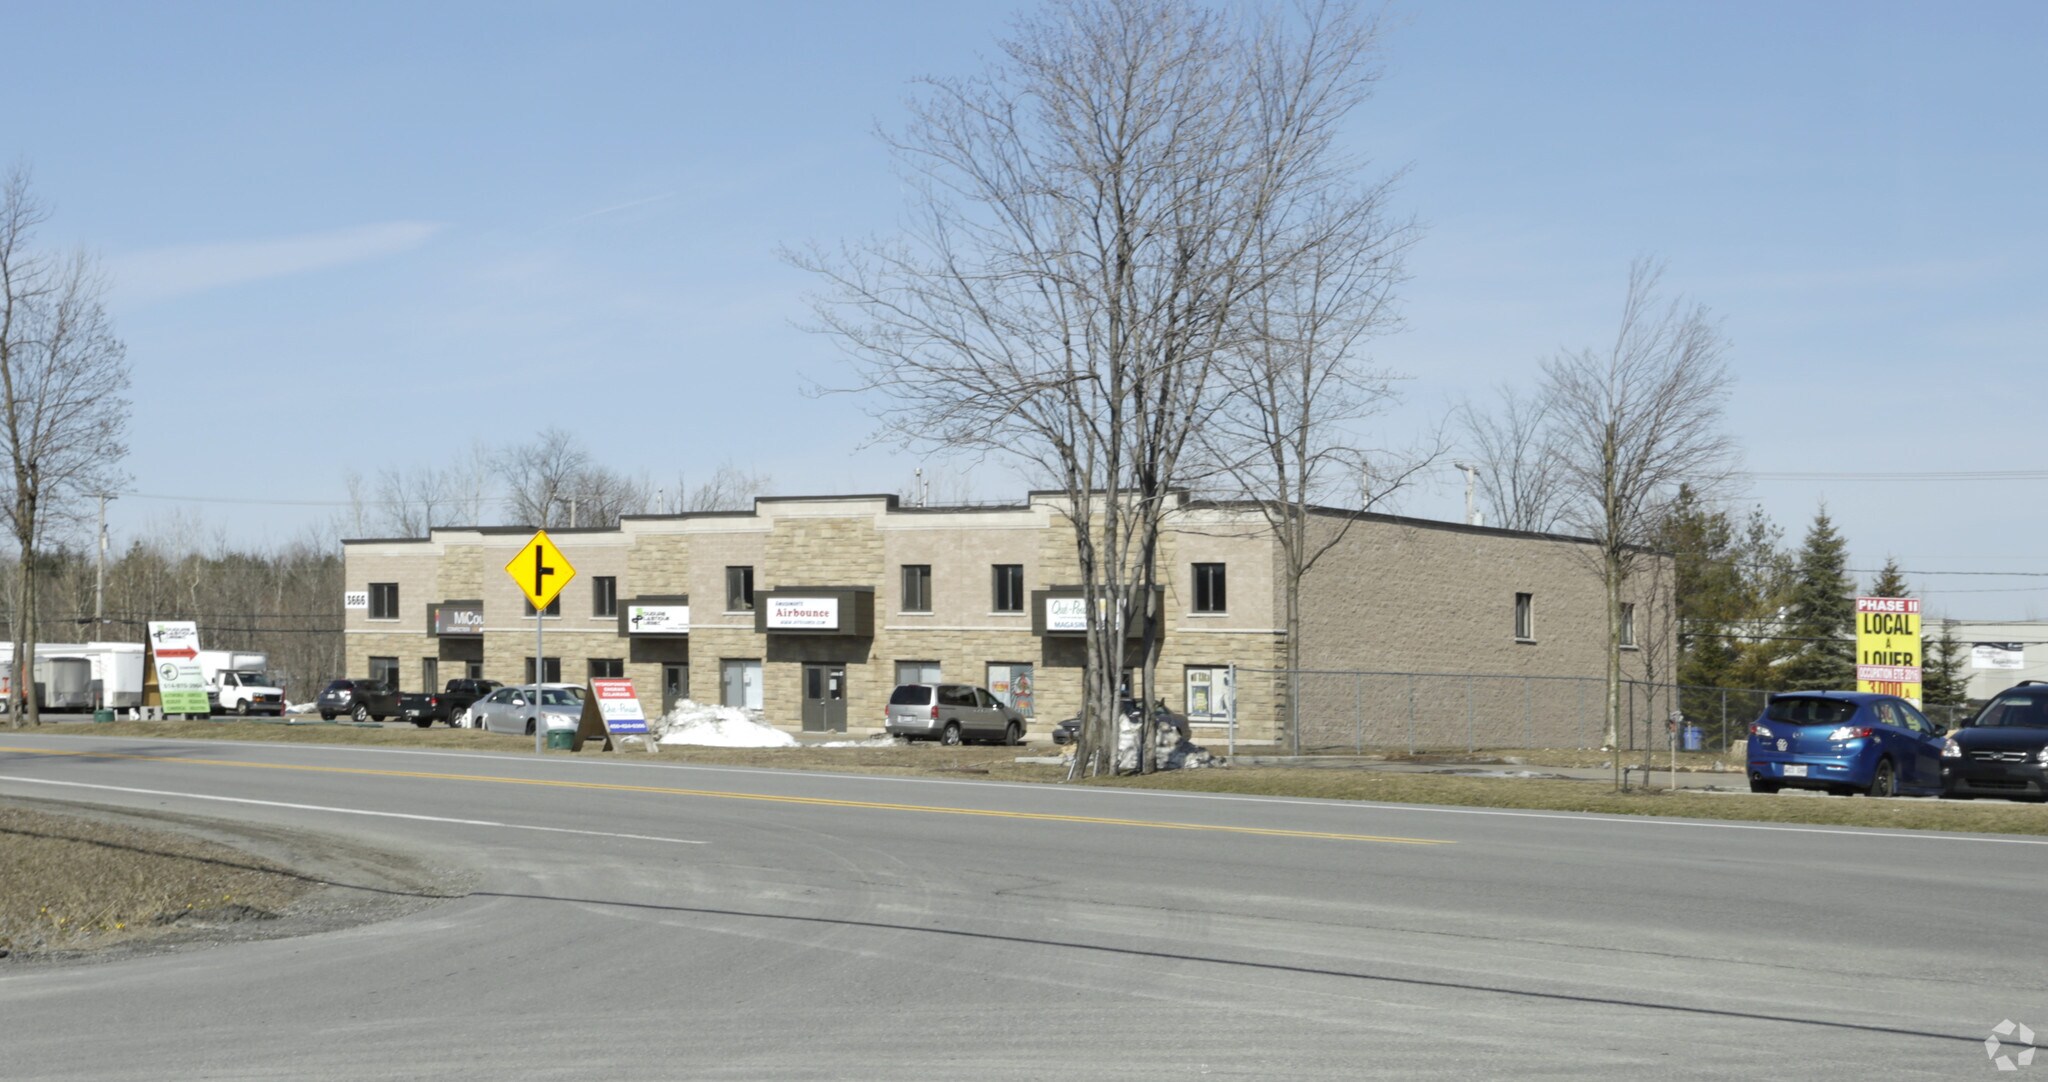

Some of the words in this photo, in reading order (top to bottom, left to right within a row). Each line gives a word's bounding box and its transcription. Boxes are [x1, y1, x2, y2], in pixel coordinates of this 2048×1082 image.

[1859, 600, 1904, 611] PHASE
[1908, 601, 1917, 611] II
[776, 608, 830, 618] Airbounce
[1864, 613, 1912, 635] LOCAL
[1864, 651, 1913, 666] LOUER
